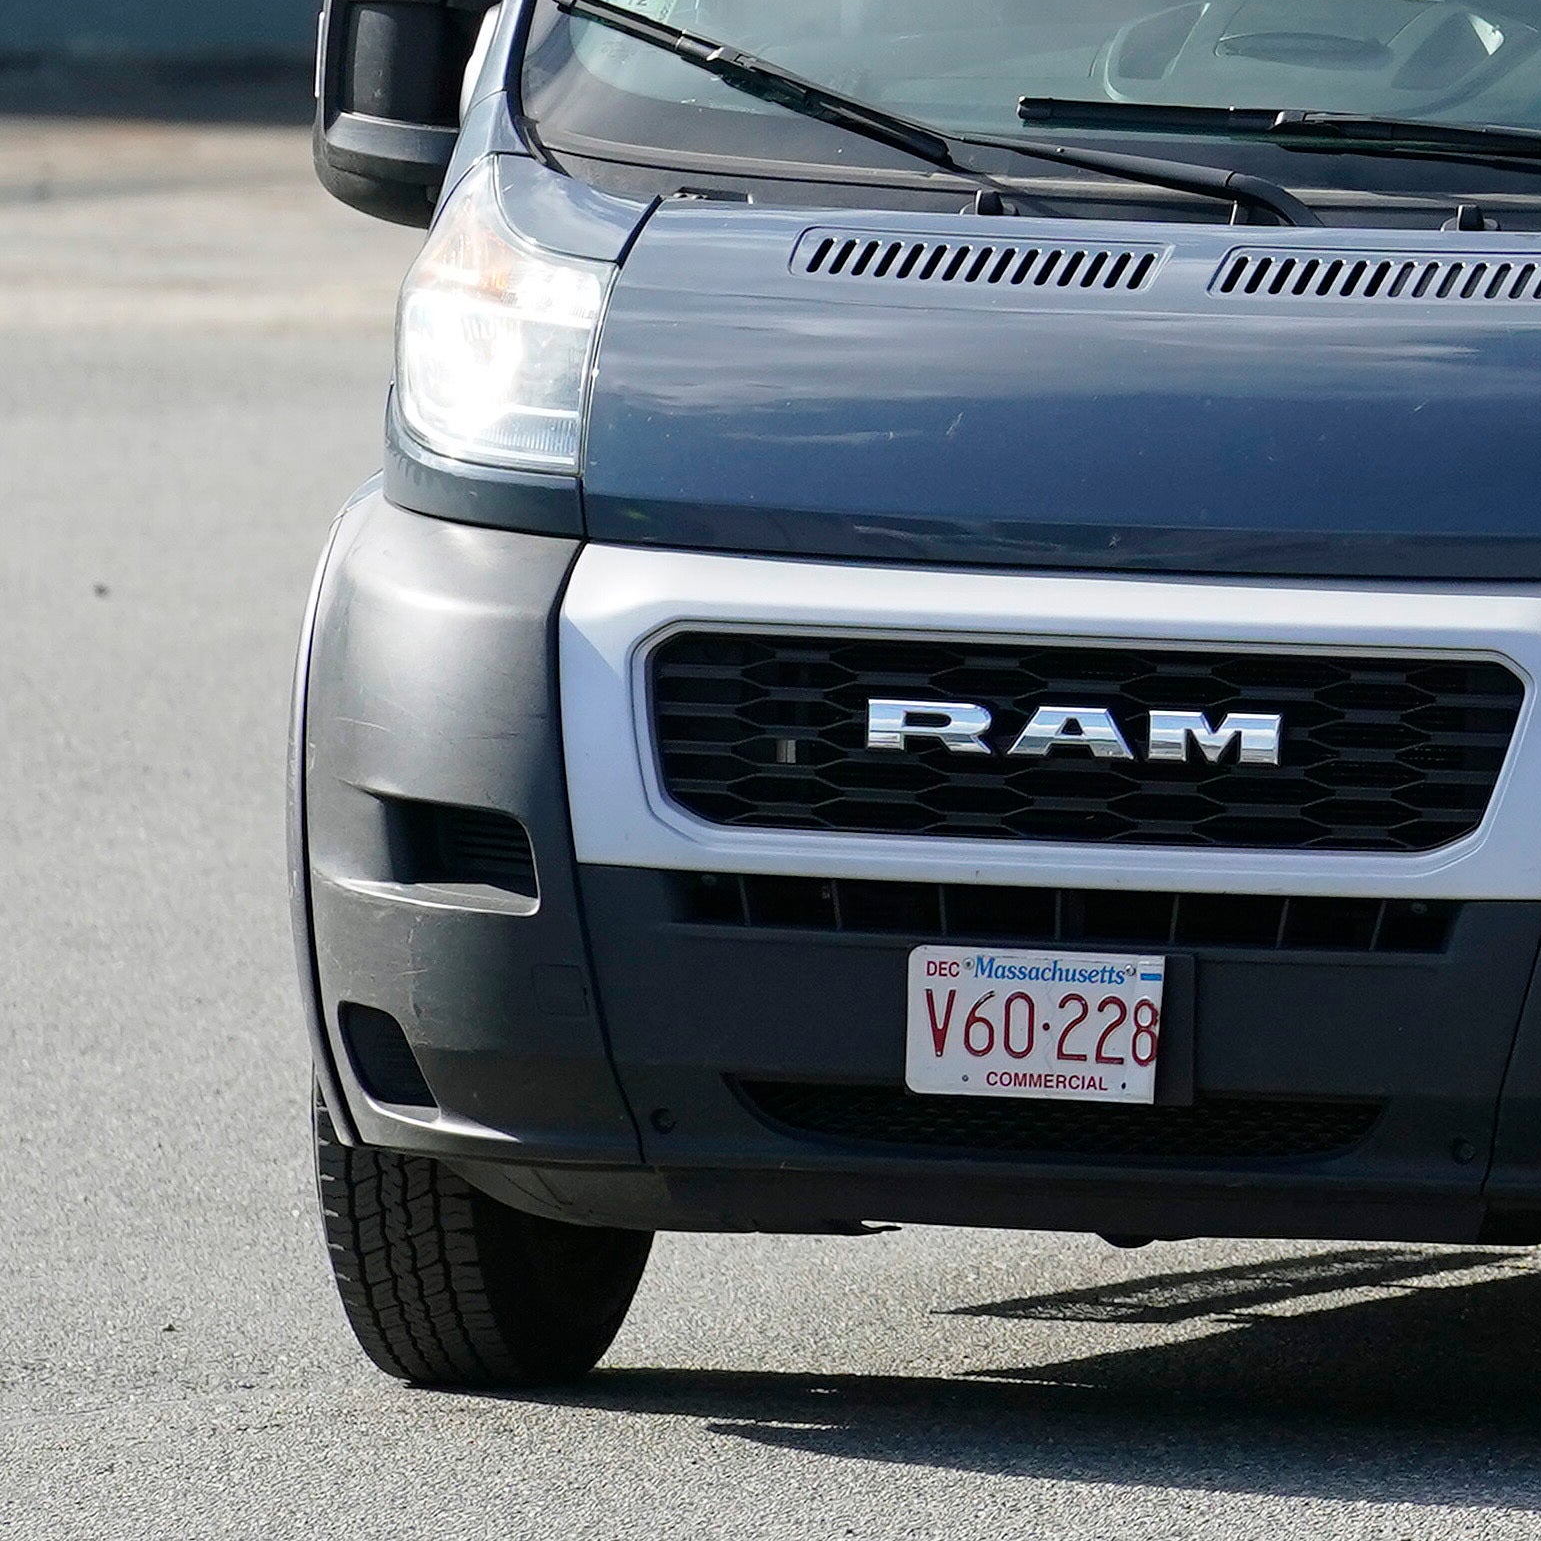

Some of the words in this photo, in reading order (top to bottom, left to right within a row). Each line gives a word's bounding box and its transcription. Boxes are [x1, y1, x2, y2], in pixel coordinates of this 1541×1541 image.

[868, 699, 1282, 766] RAM
[926, 960, 960, 977] DEC
[973, 955, 1126, 985] Massachusetts
[985, 1071, 1108, 1092] COMMERCIAL
